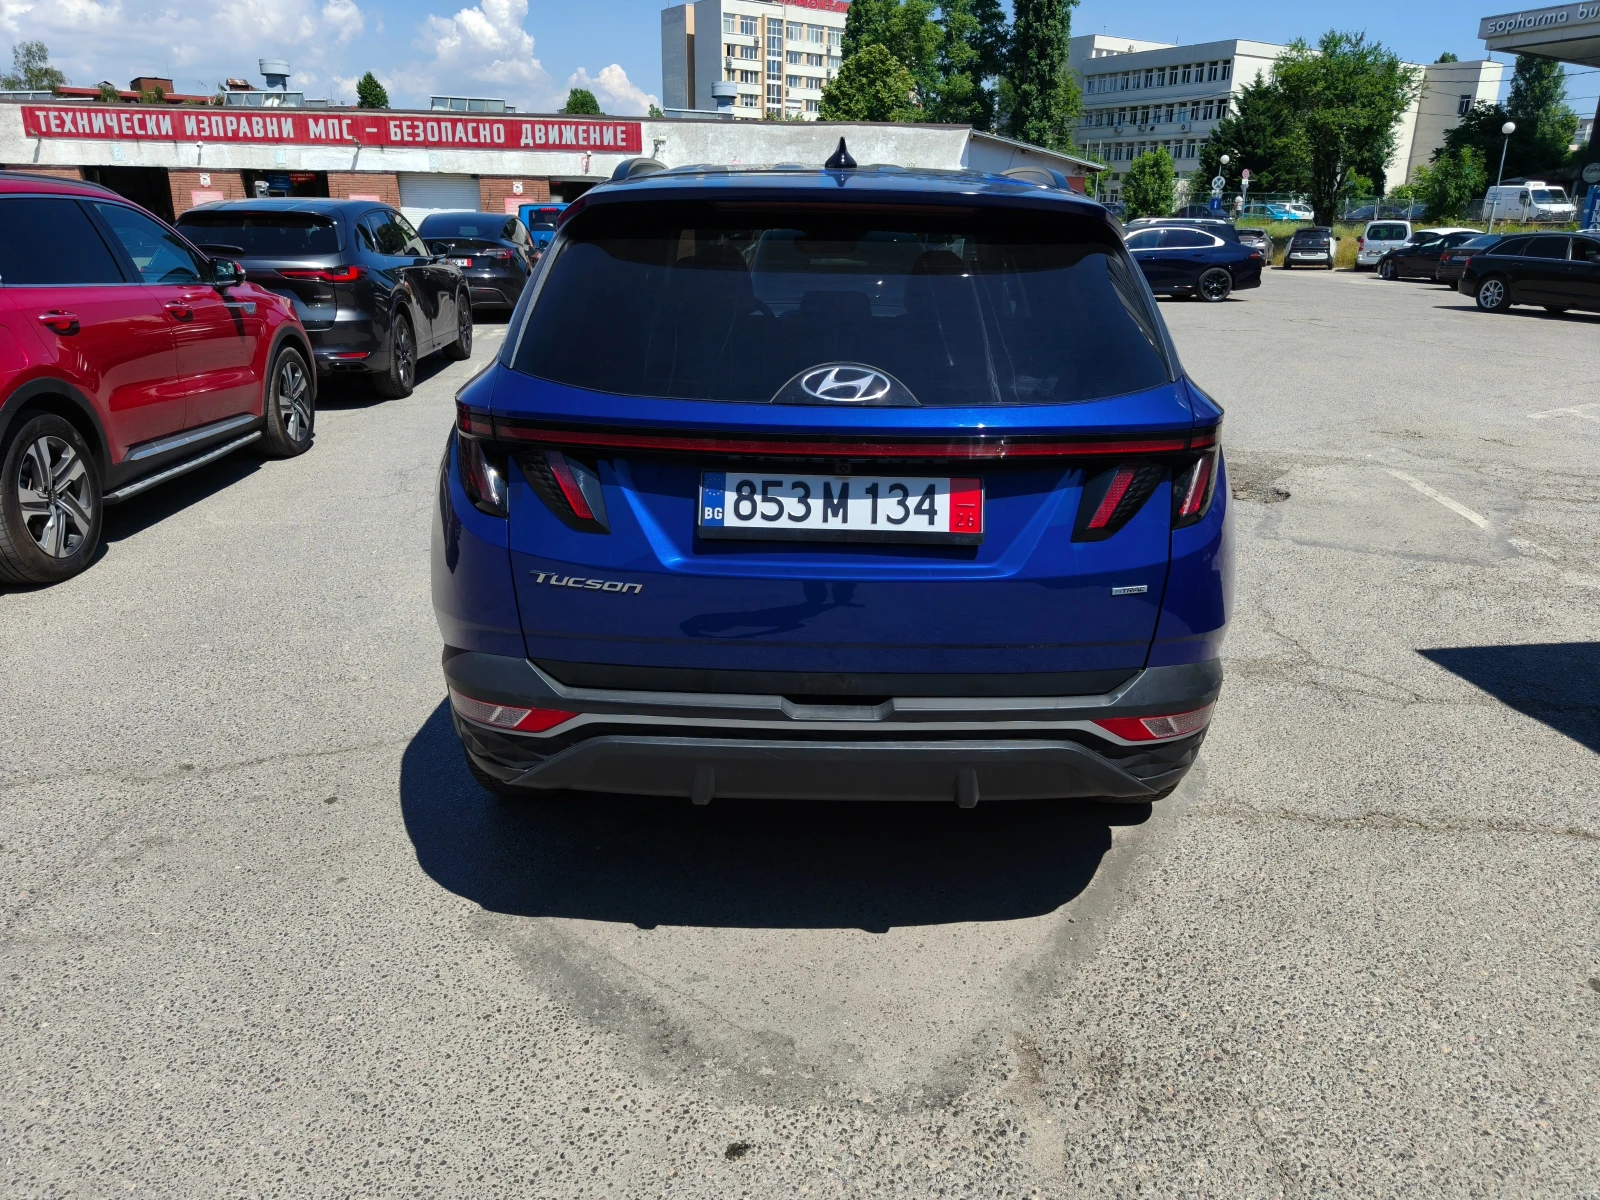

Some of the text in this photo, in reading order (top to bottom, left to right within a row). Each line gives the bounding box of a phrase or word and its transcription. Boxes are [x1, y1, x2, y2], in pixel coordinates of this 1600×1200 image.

[1487, 11, 1567, 34] sopharma
[35, 111, 173, 136] ТЕХНИЧЕСКИ
[184, 115, 294, 139] ИЗПРАВНИ
[308, 119, 354, 140] МПС
[389, 121, 505, 144] БЕЗОПАСНО
[520, 123, 627, 147] ДВИЖЕНИЕ
[114, 147, 122, 159] 6
[430, 155, 437, 166] 8
[733, 480, 811, 522] 853
[865, 482, 937, 526] 134
[704, 507, 723, 520] BG
